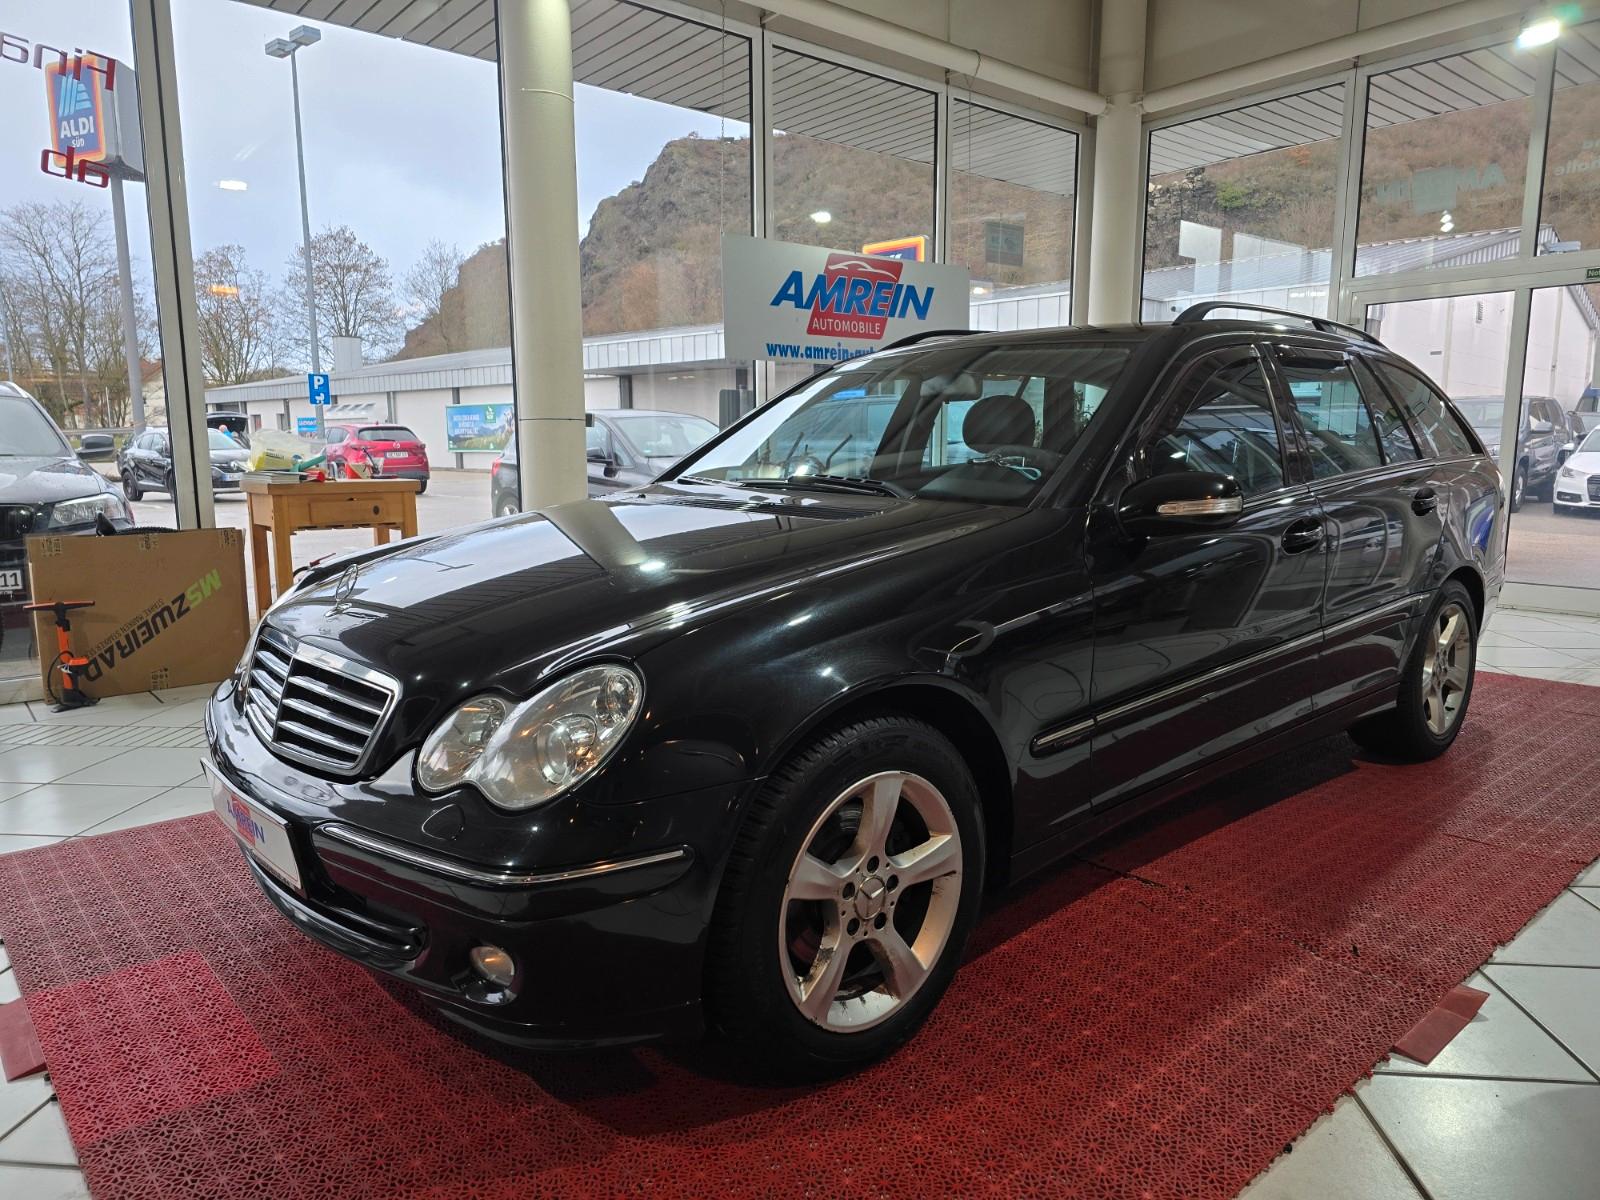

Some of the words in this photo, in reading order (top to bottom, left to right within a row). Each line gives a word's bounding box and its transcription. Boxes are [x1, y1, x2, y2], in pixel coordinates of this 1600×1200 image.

[60, 115, 95, 139] ALDI
[770, 271, 935, 320] AMREIN
[812, 317, 881, 335] AUTOMOBILE
[313, 376, 324, 389] P
